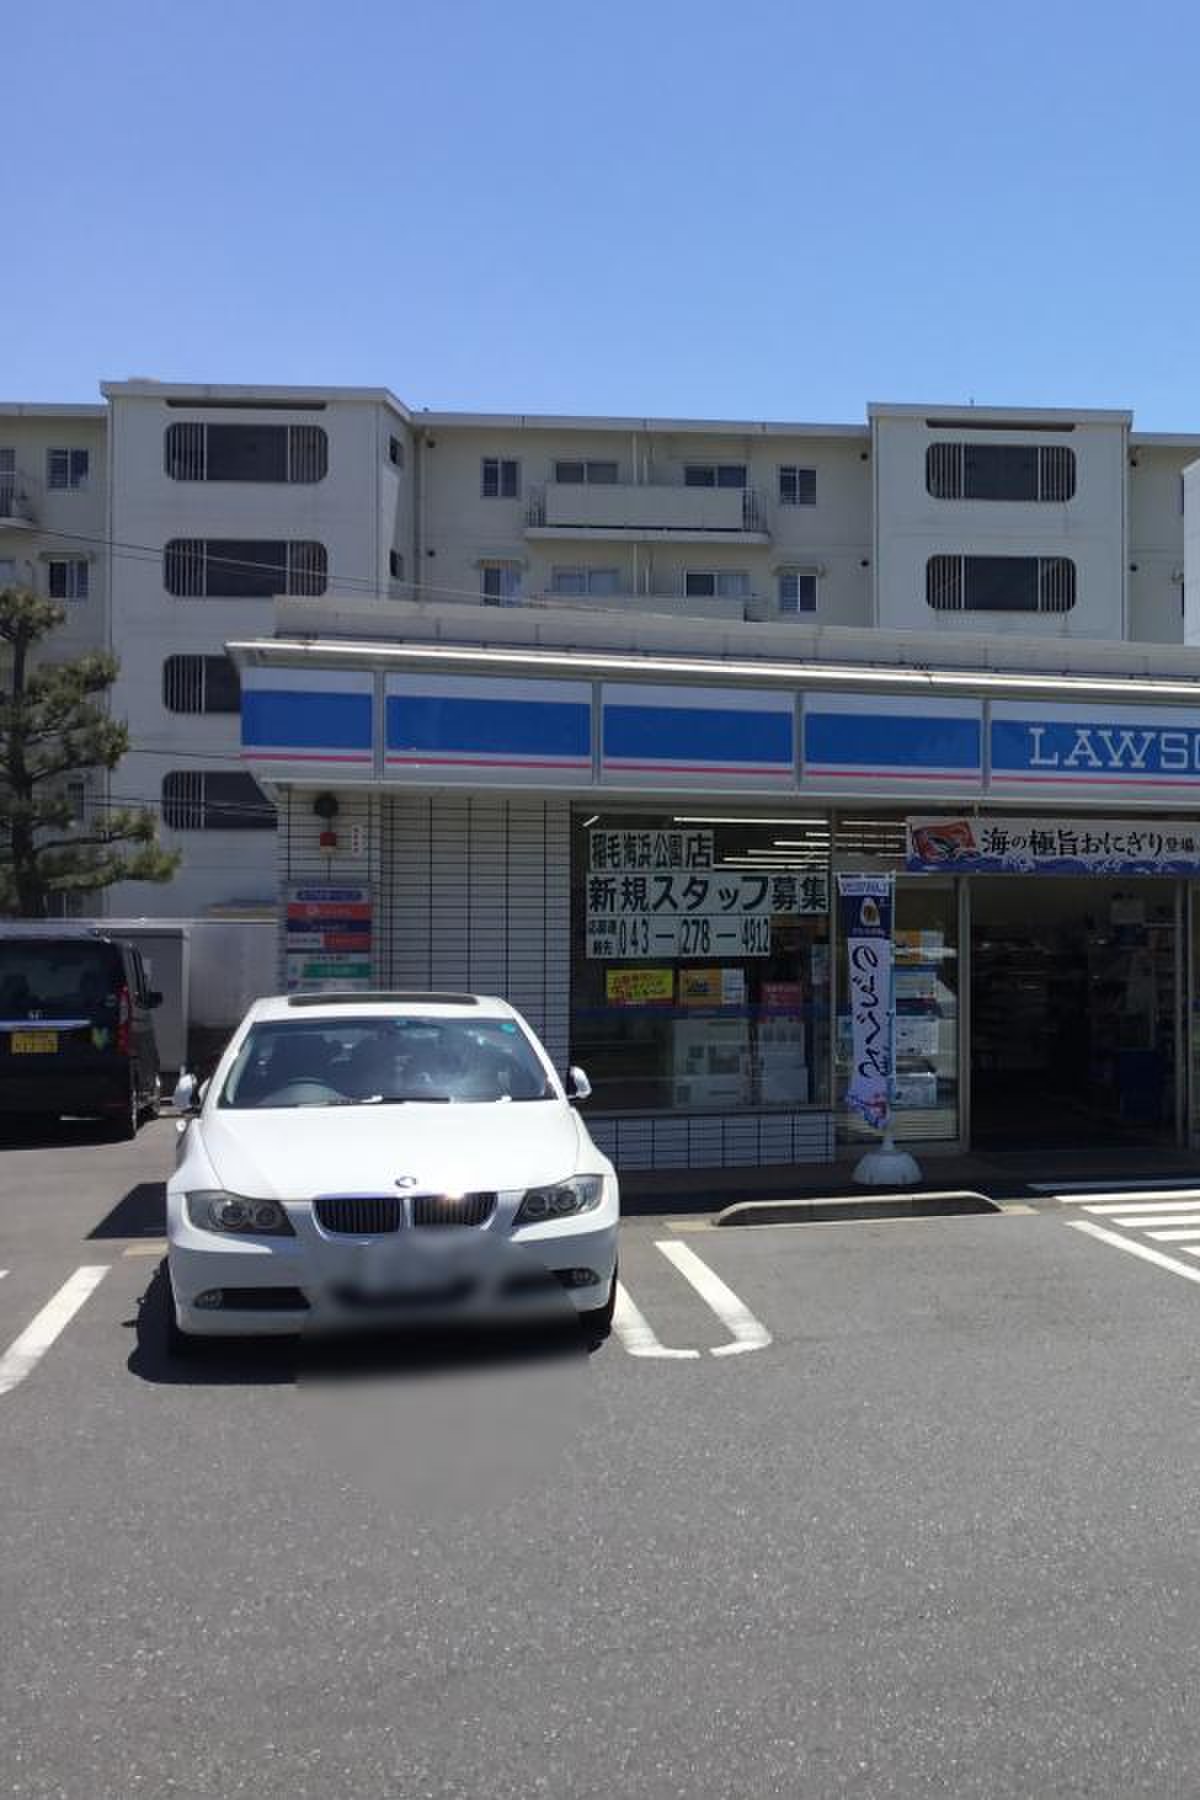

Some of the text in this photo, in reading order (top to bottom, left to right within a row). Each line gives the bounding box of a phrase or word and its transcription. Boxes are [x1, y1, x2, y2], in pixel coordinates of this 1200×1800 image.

[588, 875, 827, 913] 新規スタッフ募集
